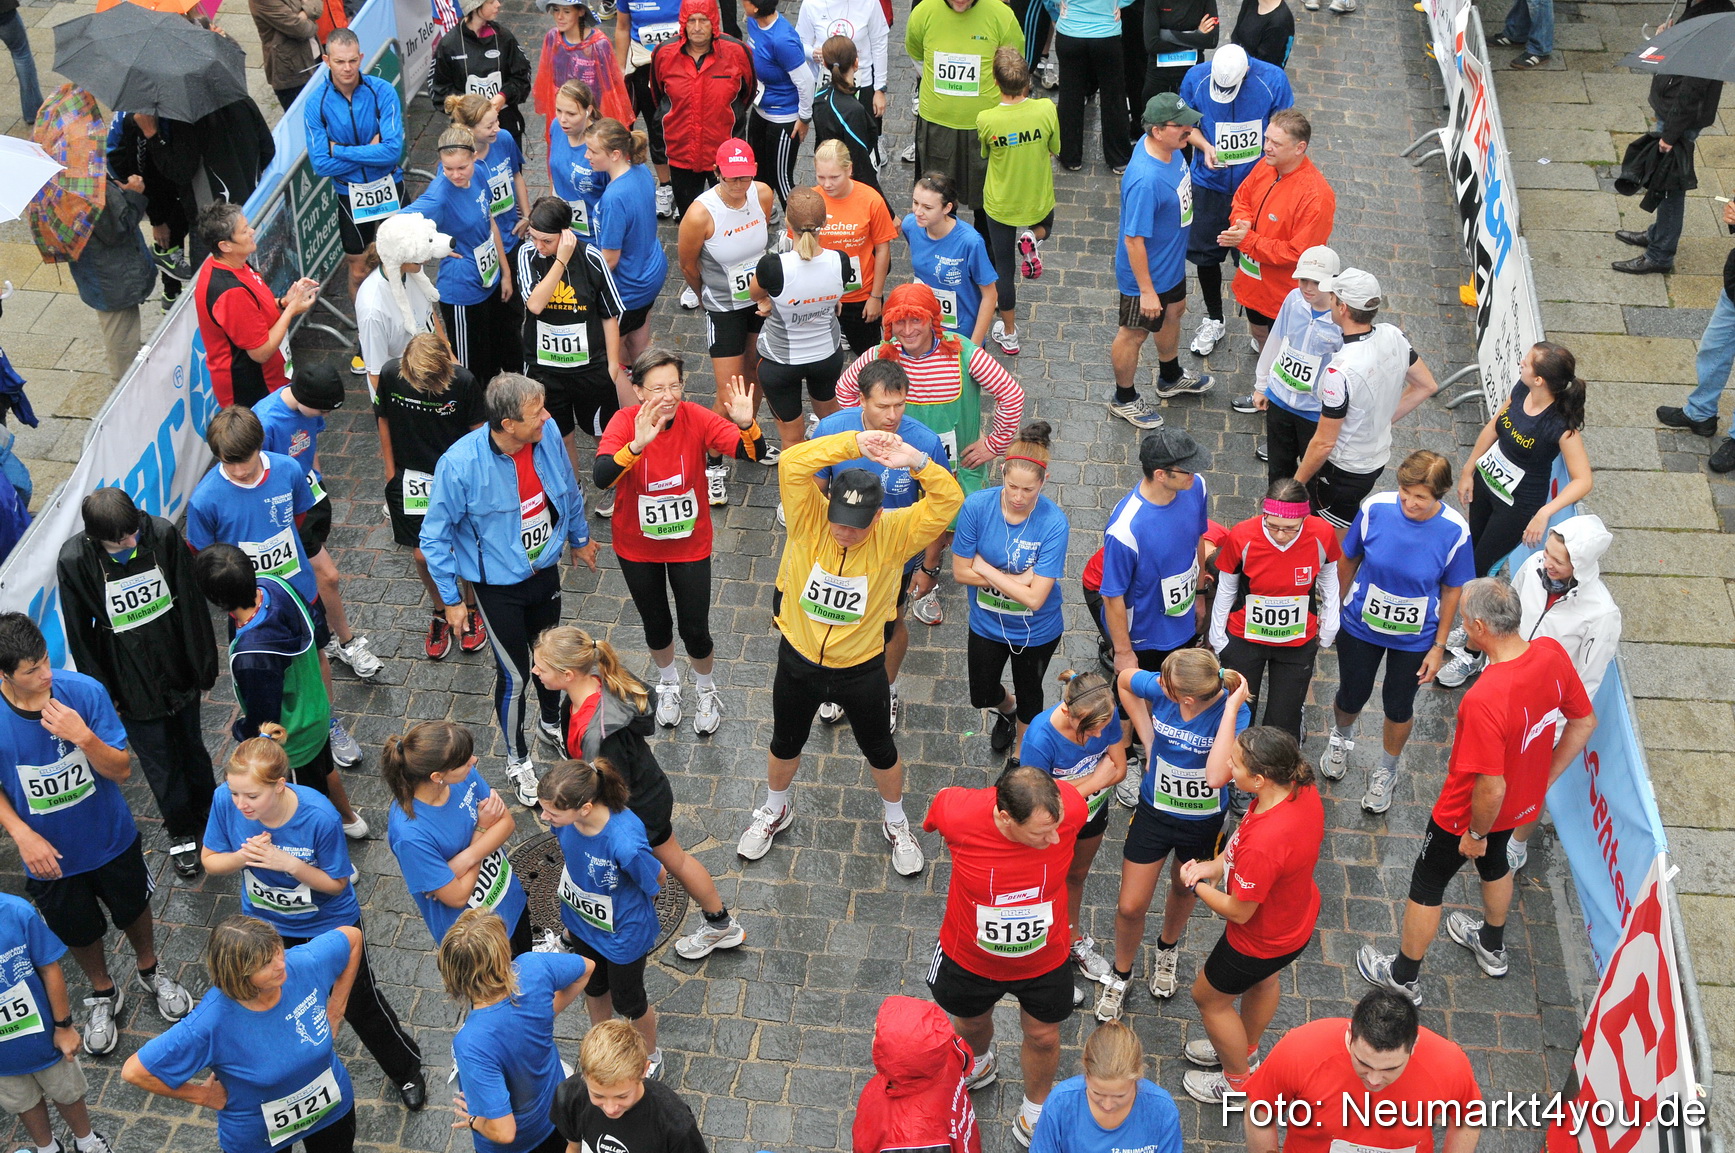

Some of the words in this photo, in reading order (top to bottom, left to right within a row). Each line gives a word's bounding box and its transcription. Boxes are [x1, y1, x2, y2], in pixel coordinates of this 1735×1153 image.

[406, 37, 418, 57] Ihr
[938, 63, 976, 81] 5074
[470, 83, 499, 101] 5030
[948, 83, 963, 91] Ivica
[1221, 131, 1258, 151] 5032
[1224, 150, 1255, 161] Sebastian
[302, 206, 319, 239] Fun
[321, 192, 330, 212] &
[734, 219, 760, 234] KLEBL
[803, 294, 839, 305] KLEBL
[542, 334, 582, 353] 5101
[550, 354, 575, 363] Marina
[1279, 352, 1313, 382] 5205
[1501, 416, 1512, 429] no
[1481, 453, 1514, 488] 5027
[646, 500, 693, 525] 5119
[657, 524, 685, 535] Beatrix
[247, 541, 293, 571] 5024
[112, 580, 163, 615] 5037
[807, 580, 861, 611] 5102
[127, 602, 159, 622] Michael
[813, 604, 846, 621] Thomas
[1252, 606, 1300, 626] 5091
[1369, 598, 1420, 624] 5153
[1261, 627, 1291, 636] Madlen
[1382, 621, 1397, 631] Eva
[29, 763, 87, 798] 5072
[1161, 773, 1214, 798] 5165
[47, 791, 79, 806] Tobias
[1170, 798, 1204, 808] Theresa
[471, 850, 502, 903] 5065
[563, 881, 607, 921] 5066
[1007, 892, 1028, 900] DEHN
[985, 919, 1045, 943] 5135
[994, 943, 1033, 953] Michael
[273, 1085, 333, 1130] 5121
[293, 1113, 321, 1131] Beate
